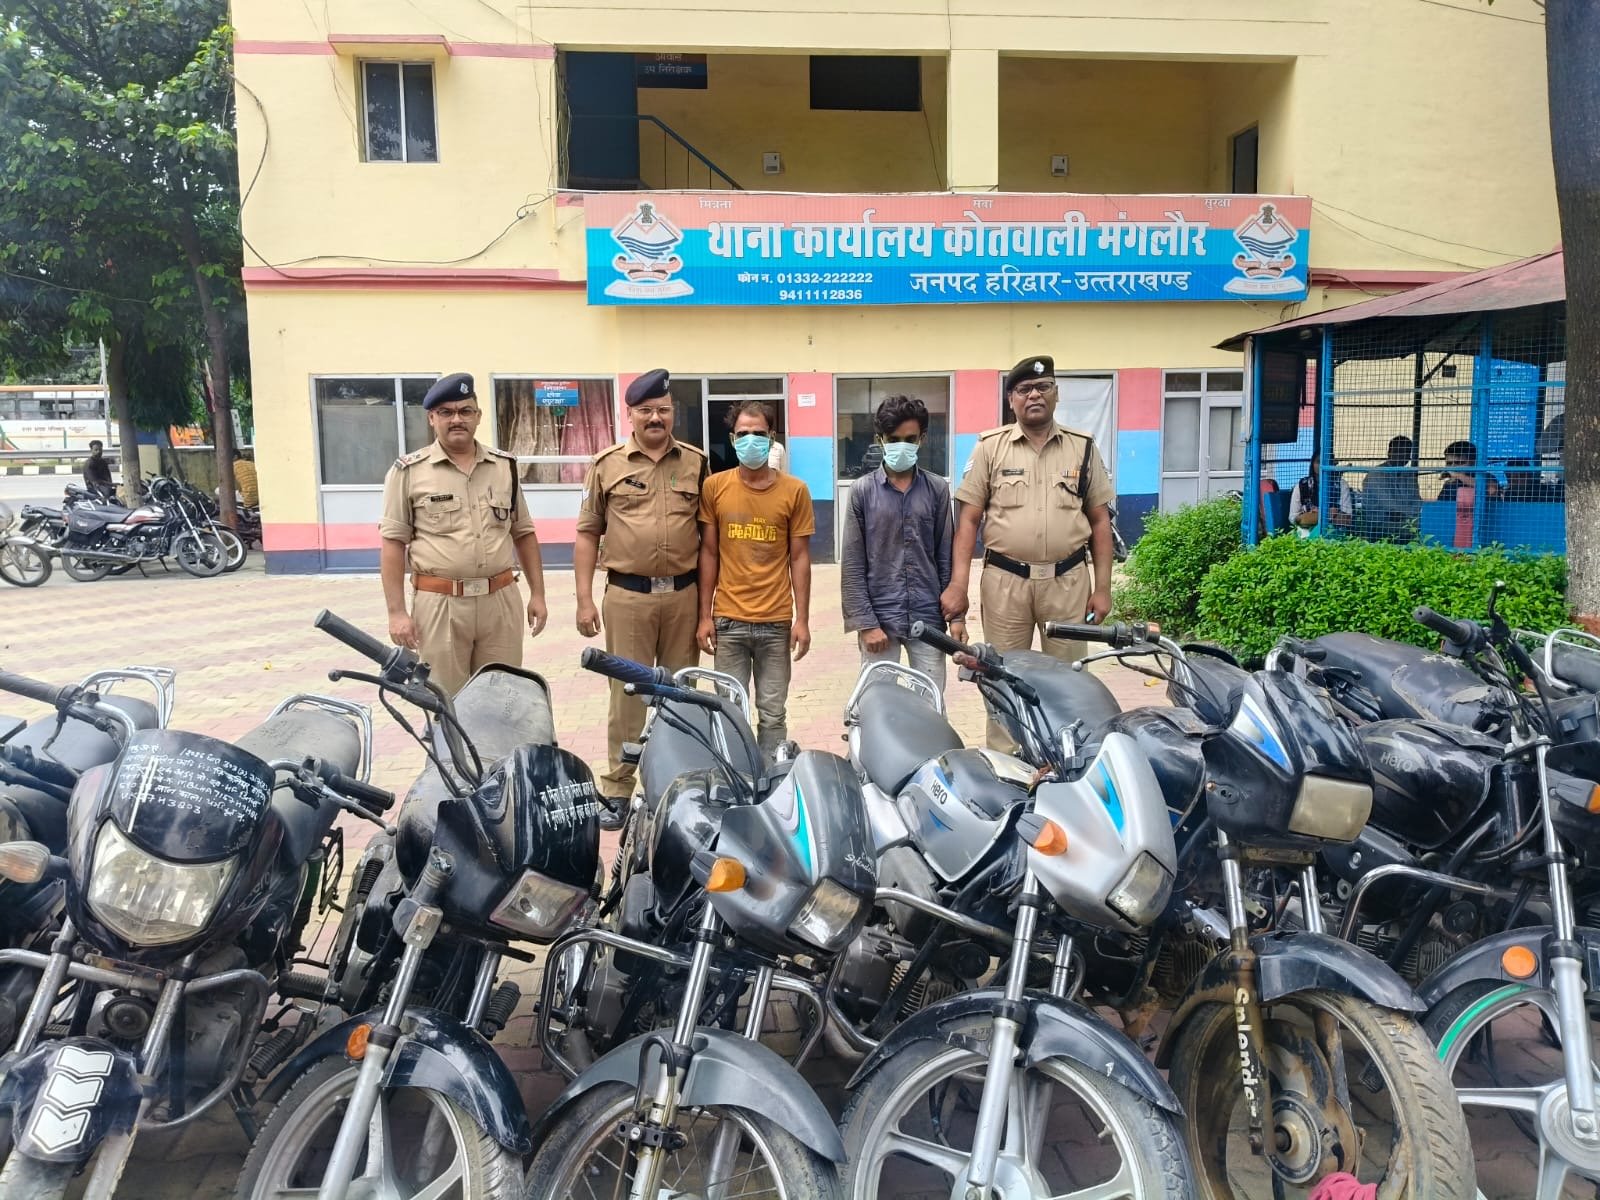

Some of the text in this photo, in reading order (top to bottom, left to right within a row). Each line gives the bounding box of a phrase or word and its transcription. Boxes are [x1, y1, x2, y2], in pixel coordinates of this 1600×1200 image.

[708, 208, 1210, 259] थाना कार्यालय कोतवाली मंगलौर
[737, 272, 759, 284] फोन
[777, 272, 873, 284] 01332-222222
[910, 272, 980, 294] जनपद
[779, 289, 863, 300] 9411112836
[728, 523, 777, 541] CREATIVE
[1380, 751, 1413, 772] Hero
[930, 779, 948, 805] Hero
